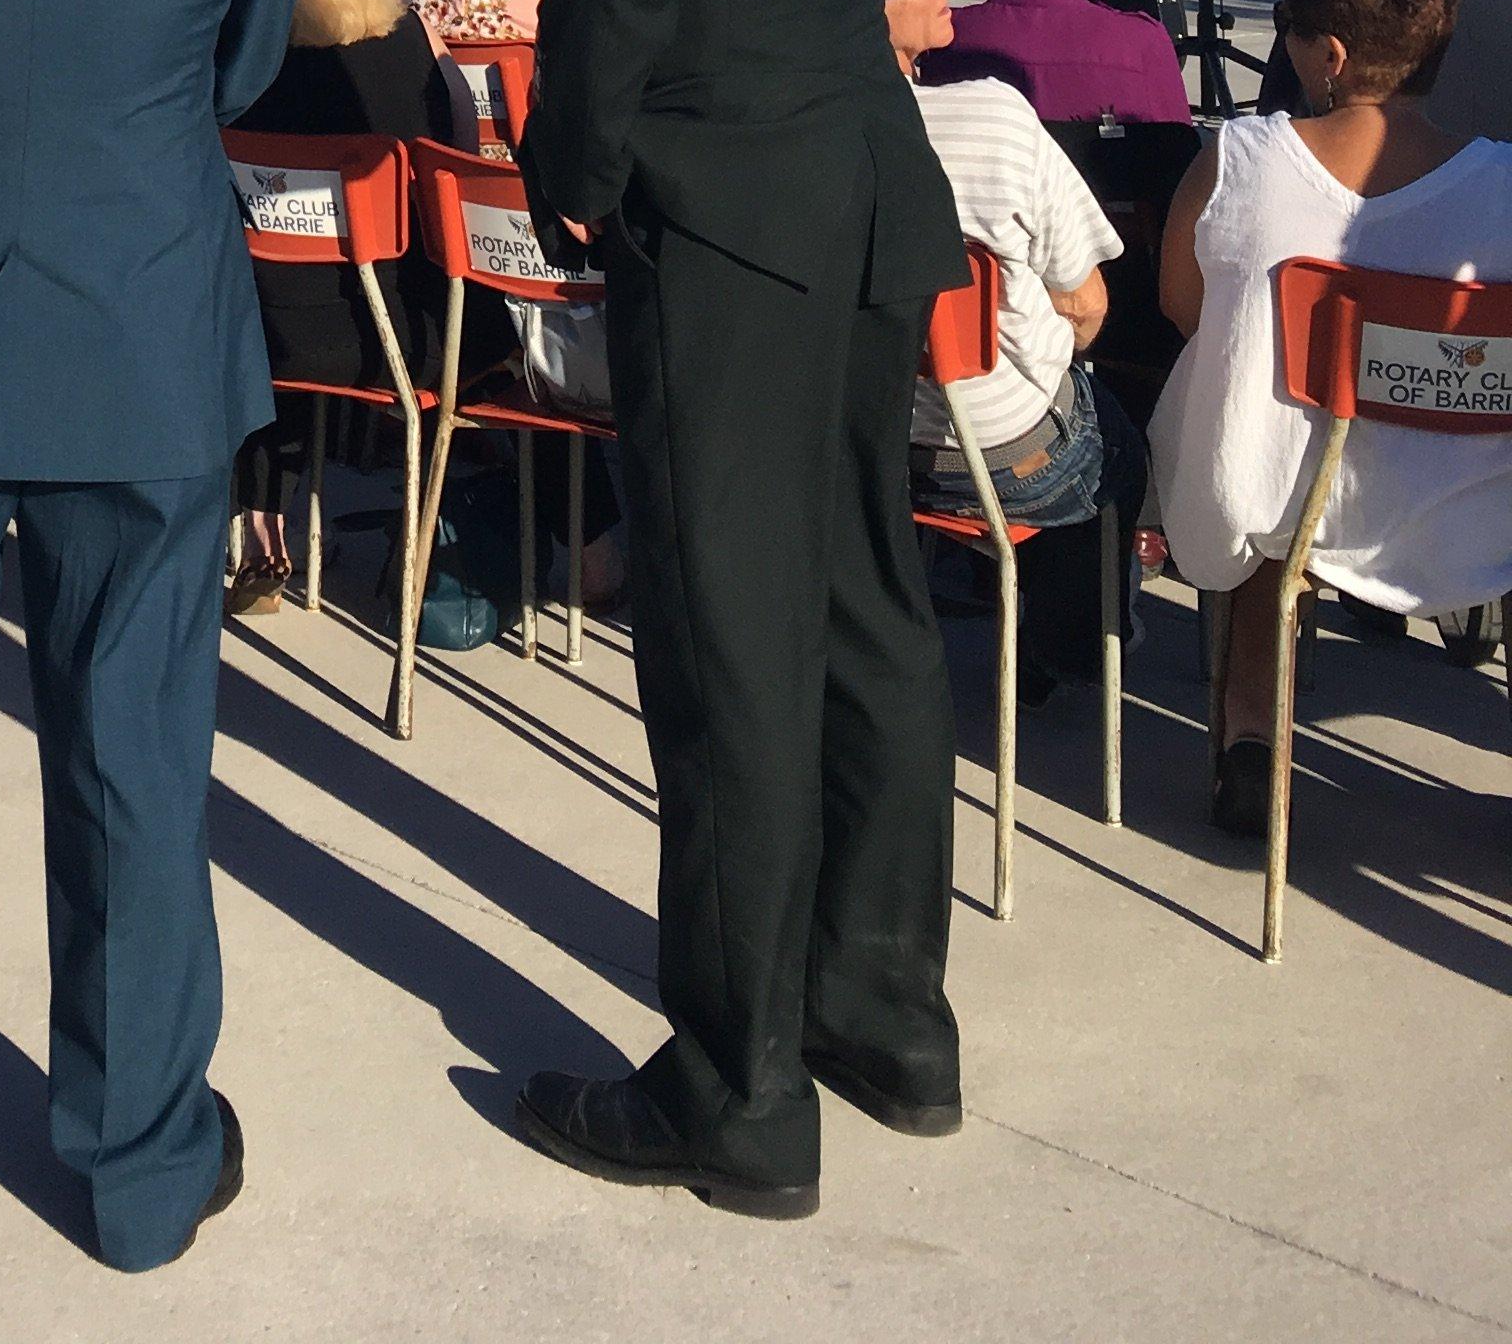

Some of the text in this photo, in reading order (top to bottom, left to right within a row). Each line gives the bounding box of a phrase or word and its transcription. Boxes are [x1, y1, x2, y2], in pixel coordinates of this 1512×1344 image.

[287, 199, 340, 217] CLUB
[259, 213, 325, 234] BARRIE
[471, 233, 537, 259] ROTARY
[488, 255, 511, 273] OF
[1367, 359, 1512, 391] ROTARY CL
[1388, 384, 1512, 412] OF BARRI
